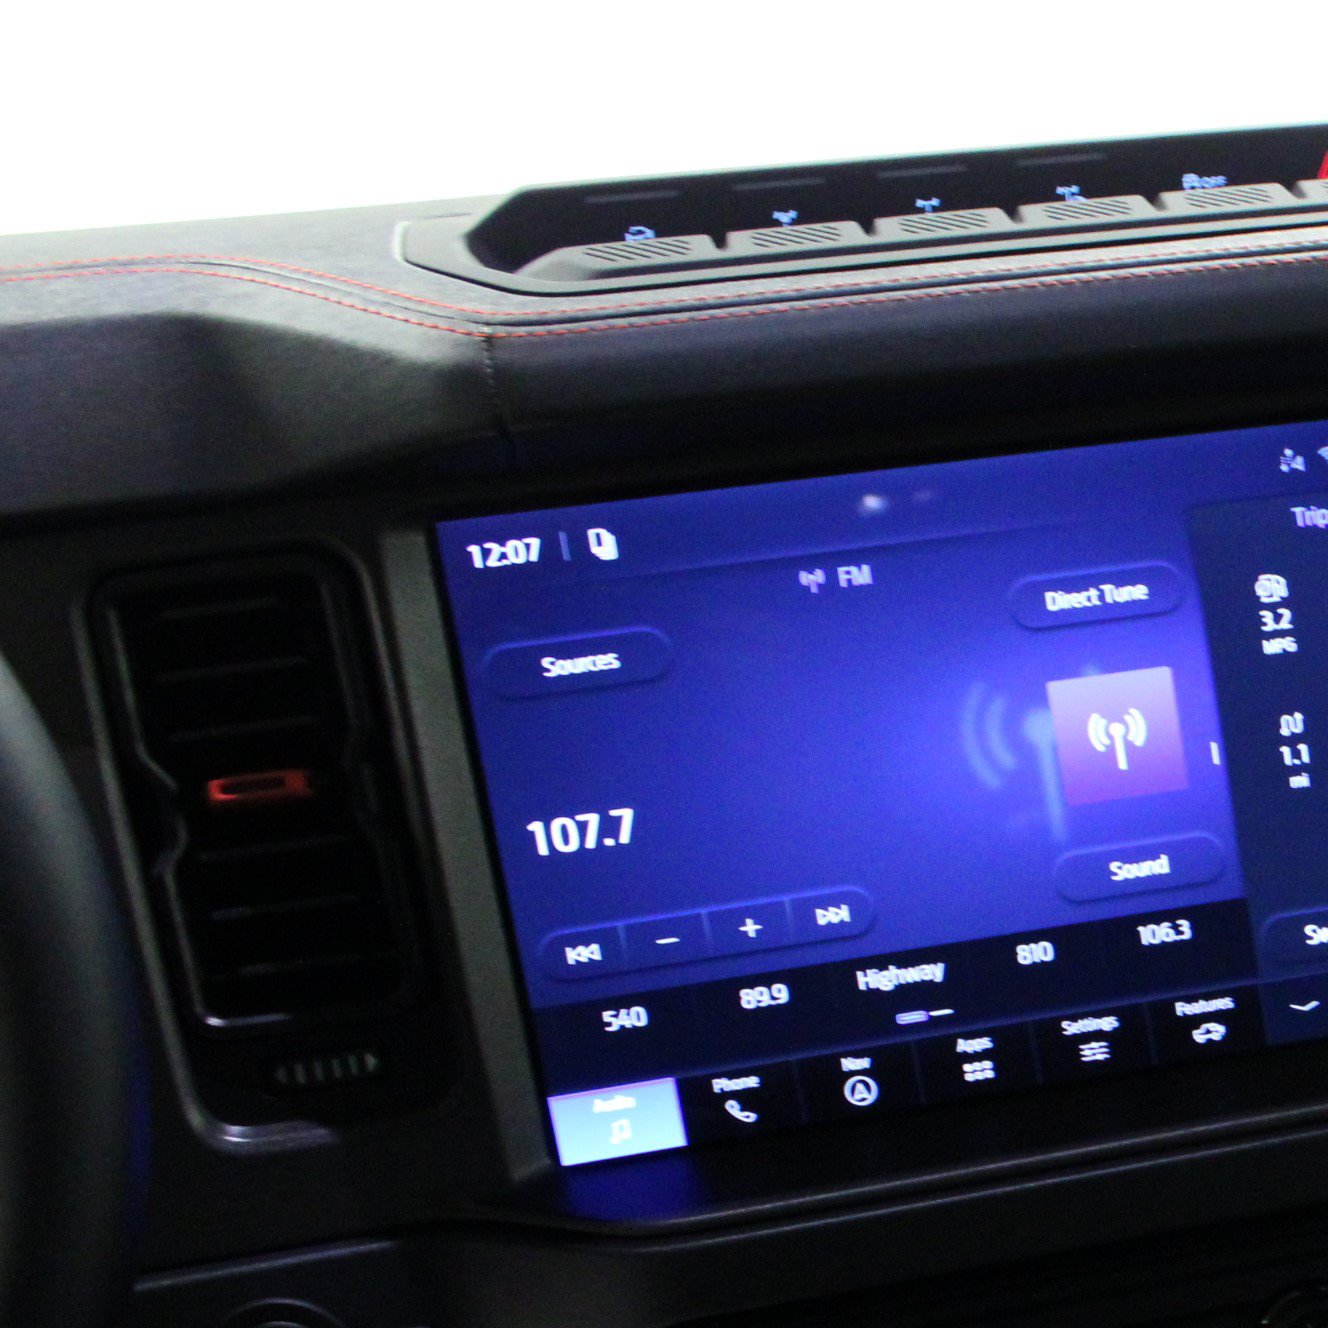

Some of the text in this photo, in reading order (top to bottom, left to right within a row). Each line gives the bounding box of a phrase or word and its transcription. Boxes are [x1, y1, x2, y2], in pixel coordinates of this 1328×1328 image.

[466, 536, 542, 568] 12:07
[837, 564, 873, 589] FM
[1044, 584, 1149, 612] Direct Tune
[1259, 608, 1294, 632] 3.2
[540, 650, 622, 678] Sources
[1278, 744, 1311, 767] 1.1
[526, 807, 635, 856] 107.7
[1108, 853, 1172, 882] Sound
[1136, 918, 1193, 946] 106.3
[1016, 940, 1055, 966] 810
[856, 961, 946, 992] Highway
[739, 983, 790, 1010] 89.9
[601, 1005, 648, 1032] 540
[1060, 1014, 1120, 1037] Settings
[711, 1073, 761, 1094] Phone
